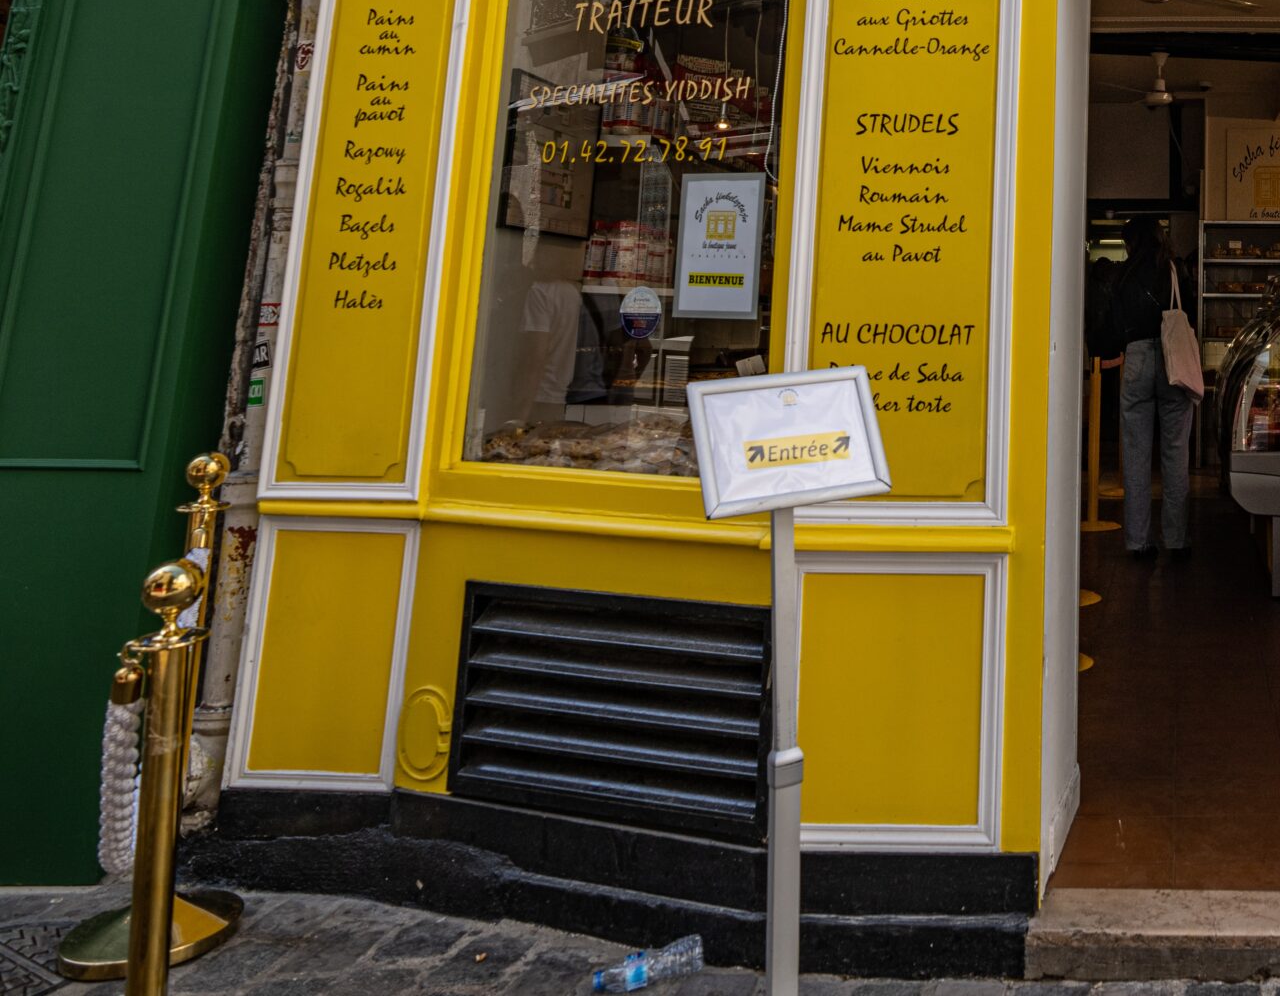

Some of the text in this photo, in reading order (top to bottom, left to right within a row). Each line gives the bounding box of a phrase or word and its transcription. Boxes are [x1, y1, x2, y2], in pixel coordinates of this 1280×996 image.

[366, 8, 415, 26] Pains
[856, 8, 969, 31] aux Griottes
[379, 30, 400, 41] au
[359, 39, 416, 55] cumin
[833, 37, 990, 62] Cannelle-Orange
[356, 73, 409, 92] Pains
[528, 79, 654, 109] SPECIALITES
[665, 76, 751, 102] YIDDISH
[370, 95, 392, 106] au
[354, 105, 406, 128] pavot
[856, 113, 960, 136] STRUDELS
[344, 140, 406, 165] Razowy
[541, 135, 728, 164] 01.42.72.78.91
[861, 156, 950, 175] Viennois
[336, 177, 407, 202] Rogalik
[859, 185, 949, 205] Roumain
[339, 214, 395, 240] Bagels
[838, 214, 967, 235] Mame Strudel
[328, 252, 397, 277] Pletzels
[862, 244, 942, 263] au Pavot
[688, 274, 744, 286] BIENVENUE
[334, 290, 383, 309] Halès
[821, 322, 976, 346] AU CHOCOLAT
[888, 362, 910, 381] de
[917, 363, 964, 384] Saba
[906, 395, 952, 413] torte
[767, 440, 829, 462] Entrée
